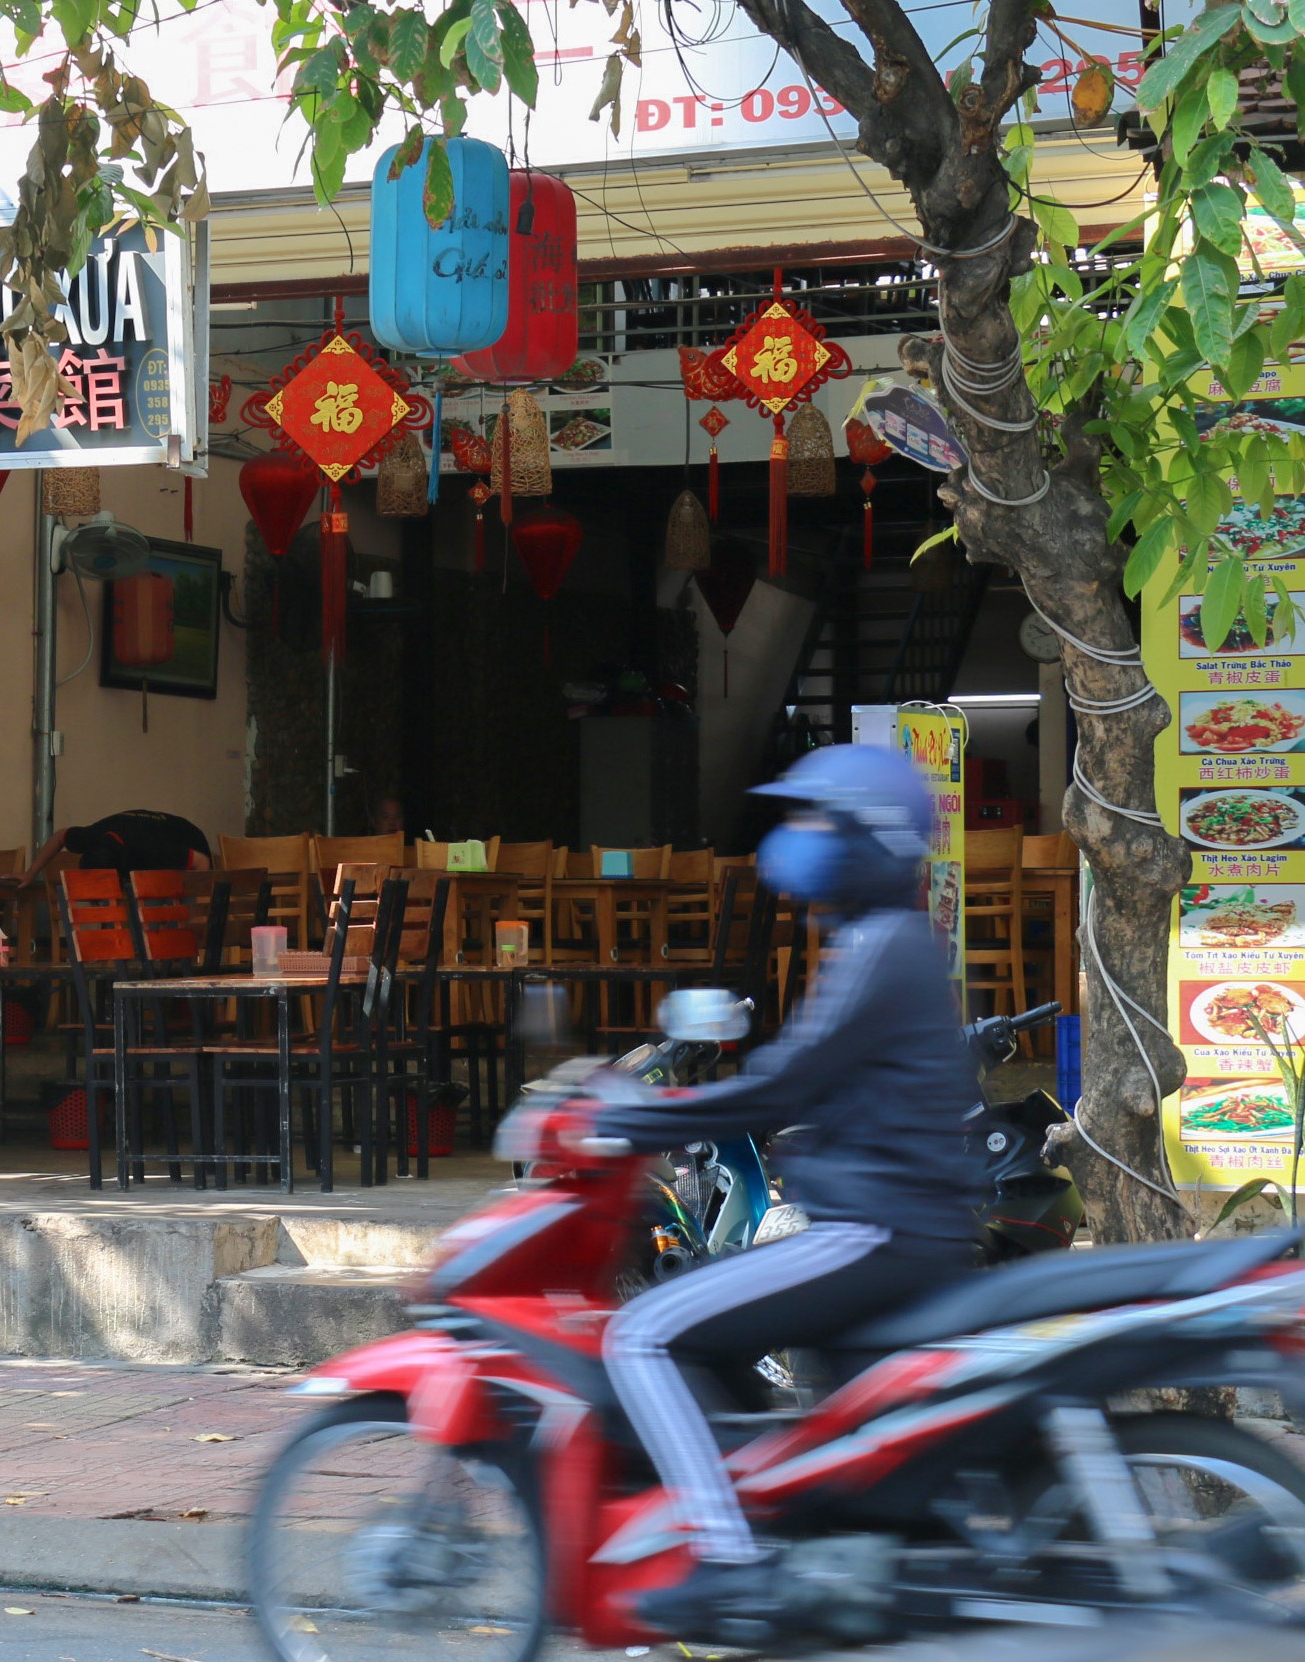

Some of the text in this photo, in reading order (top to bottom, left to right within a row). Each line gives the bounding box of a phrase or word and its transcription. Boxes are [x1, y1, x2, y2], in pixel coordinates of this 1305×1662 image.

[635, 52, 1147, 132] ĐT: 093 25
[751, 336, 797, 384] 福
[147, 360, 167, 376] ĐT:
[143, 380, 171, 391] 0935
[1209, 379, 1281, 396] 麻豆腐
[147, 396, 168, 408] 358
[310, 381, 363, 434] 福
[147, 414, 168, 426] 295
[1197, 662, 1217, 670] Salat
[1208, 670, 1281, 684] 青椒皮蛋
[1216, 758, 1237, 766] Chua
[1199, 766, 1290, 780] 西红柿炒蛋
[1221, 854, 1237, 862] Heo
[1208, 864, 1281, 877] 水煮肉片
[1199, 962, 1291, 975] 椒盐皮皮虾
[1219, 1058, 1273, 1072] 香辣蟹
[1209, 1155, 1283, 1168] 青椒肉丝
